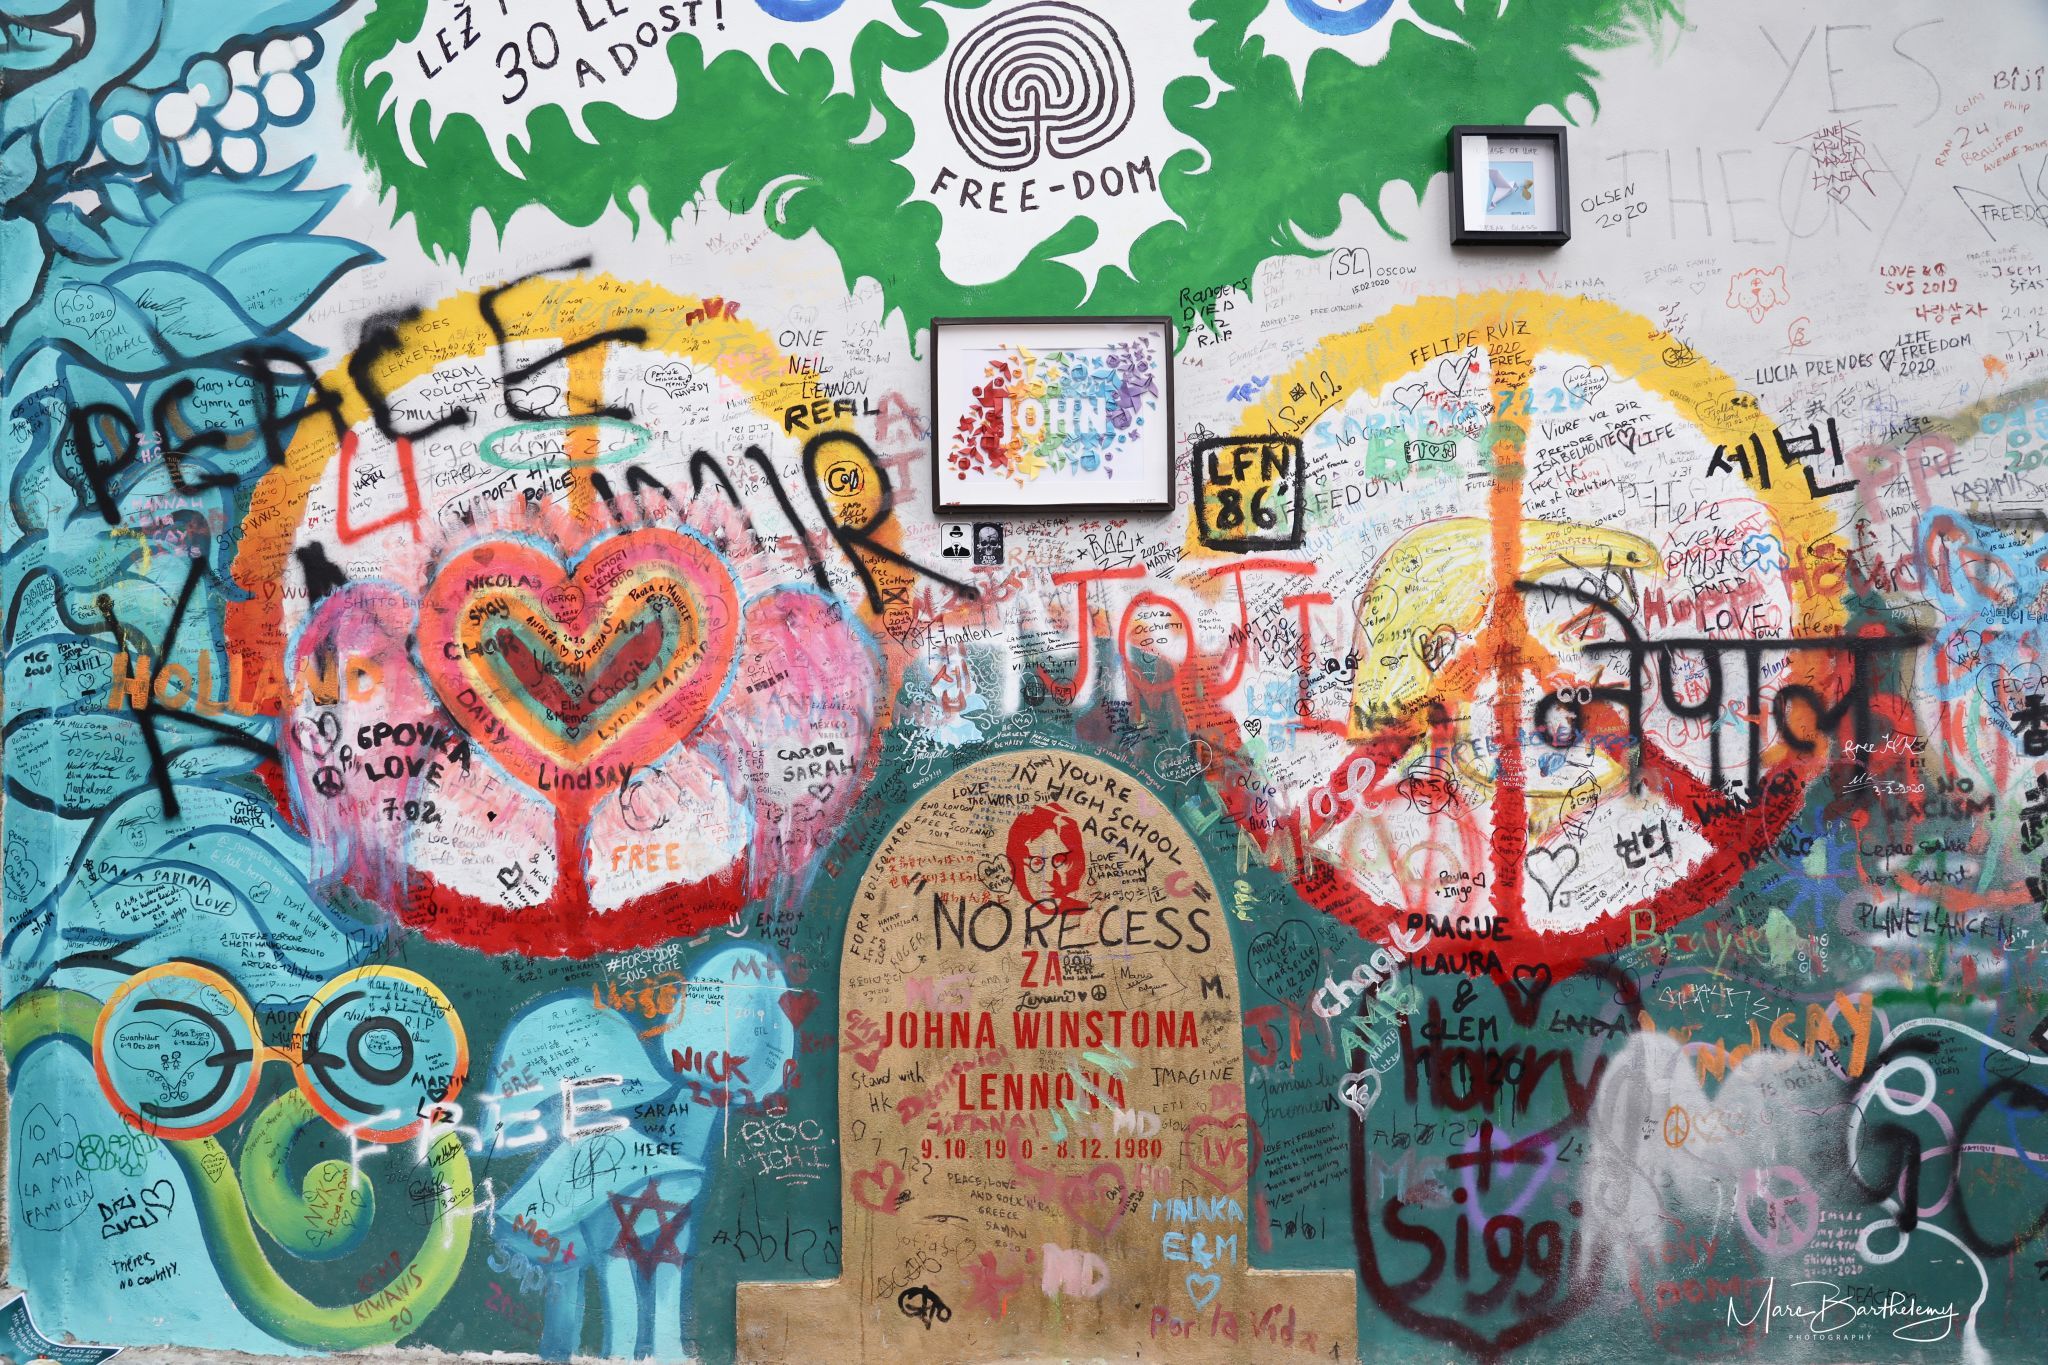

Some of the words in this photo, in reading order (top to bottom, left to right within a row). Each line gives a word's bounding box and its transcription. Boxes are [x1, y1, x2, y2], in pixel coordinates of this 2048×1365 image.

[495, 21, 560, 105] 30
[574, 58, 606, 88] A
[929, 155, 1158, 214] FREE-DOM
[1580, 182, 1635, 214] OLSEN
[1595, 202, 1648, 229] 2020
[1879, 265, 1916, 278] LOVE
[1178, 278, 1248, 307] Rangers
[1922, 278, 1958, 293] 2019
[58, 294, 95, 314] KGS
[778, 330, 830, 348] ONE
[1409, 329, 1481, 365] FELIPE
[1488, 341, 1522, 355] 2020
[1901, 333, 1972, 361] FREEDOM
[788, 355, 829, 376] NEIL
[1488, 351, 1525, 366] FREE
[1755, 363, 1798, 385] LUCIA
[1805, 353, 1874, 377] PRENDES
[1899, 358, 1935, 377] 2020
[431, 365, 481, 384] FROM
[801, 378, 869, 399] LENNON
[192, 394, 234, 411] Cymru
[204, 418, 229, 429] Dec
[234, 418, 245, 428] 19
[784, 398, 881, 433] REAL
[1001, 396, 1108, 445] JOHN
[1637, 423, 1676, 448] LIFE
[1207, 443, 1290, 486] LFN
[1705, 417, 1861, 500] 세빈
[521, 471, 576, 502] POLICE
[1464, 480, 1499, 492] FUTURE
[1527, 477, 1558, 495] Free
[1556, 465, 1585, 483] HK
[1523, 496, 1548, 513] Time
[1550, 491, 1561, 504] of
[1538, 506, 1567, 521] PEACE
[1140, 542, 1165, 558] 2020
[465, 575, 542, 591] NICOLAS
[590, 562, 625, 590] VENCE
[602, 620, 646, 635] SAM
[1703, 604, 1769, 633] LOVE
[23, 651, 50, 663] MG
[1027, 661, 1047, 670] AMO
[1760, 656, 1794, 678] Blanca
[560, 700, 581, 712] Elis
[777, 741, 846, 761] CAROL
[364, 755, 446, 790] LOVE
[782, 756, 858, 783] SARAH
[951, 781, 991, 800] LOVE
[932, 810, 957, 821] RULE
[1046, 777, 1105, 814] HIGH
[1106, 807, 1183, 866] SCHOOL
[928, 831, 950, 840] 2019
[1081, 815, 1156, 867] AGAIN
[611, 842, 682, 873] FREE
[1098, 851, 1119, 862] LOVE
[850, 912, 871, 956] FORA
[865, 822, 912, 903] BOLSONARO
[194, 893, 234, 914] LOVE
[1406, 911, 1513, 942] PRAGUE
[1020, 950, 1062, 989] ZA
[1419, 950, 1505, 977] LAURA
[1452, 979, 1479, 1013] &
[881, 1011, 997, 1049] JOHNA
[1013, 1011, 1199, 1049] WINSTONA
[672, 1046, 751, 1084] NICK
[852, 1069, 891, 1091] Stand
[898, 1061, 926, 1084] with
[411, 1072, 471, 1091] MARTIN
[1151, 1067, 1234, 1087] IMAGINE
[633, 1104, 691, 1120] SARAH
[868, 1092, 894, 1113] HK
[643, 1124, 676, 1138] WAS
[1113, 1107, 1161, 1137] MD
[634, 1141, 683, 1156] HERE
[985, 1140, 1033, 1159] 190
[1057, 1139, 1162, 1159] 8.12.1980
[978, 1205, 1019, 1220] GREECE
[1040, 1243, 1111, 1300] MD
[352, 1263, 424, 1323] KIWANIS
[389, 1308, 413, 1332] 20
[1150, 1306, 1196, 1340] Por
